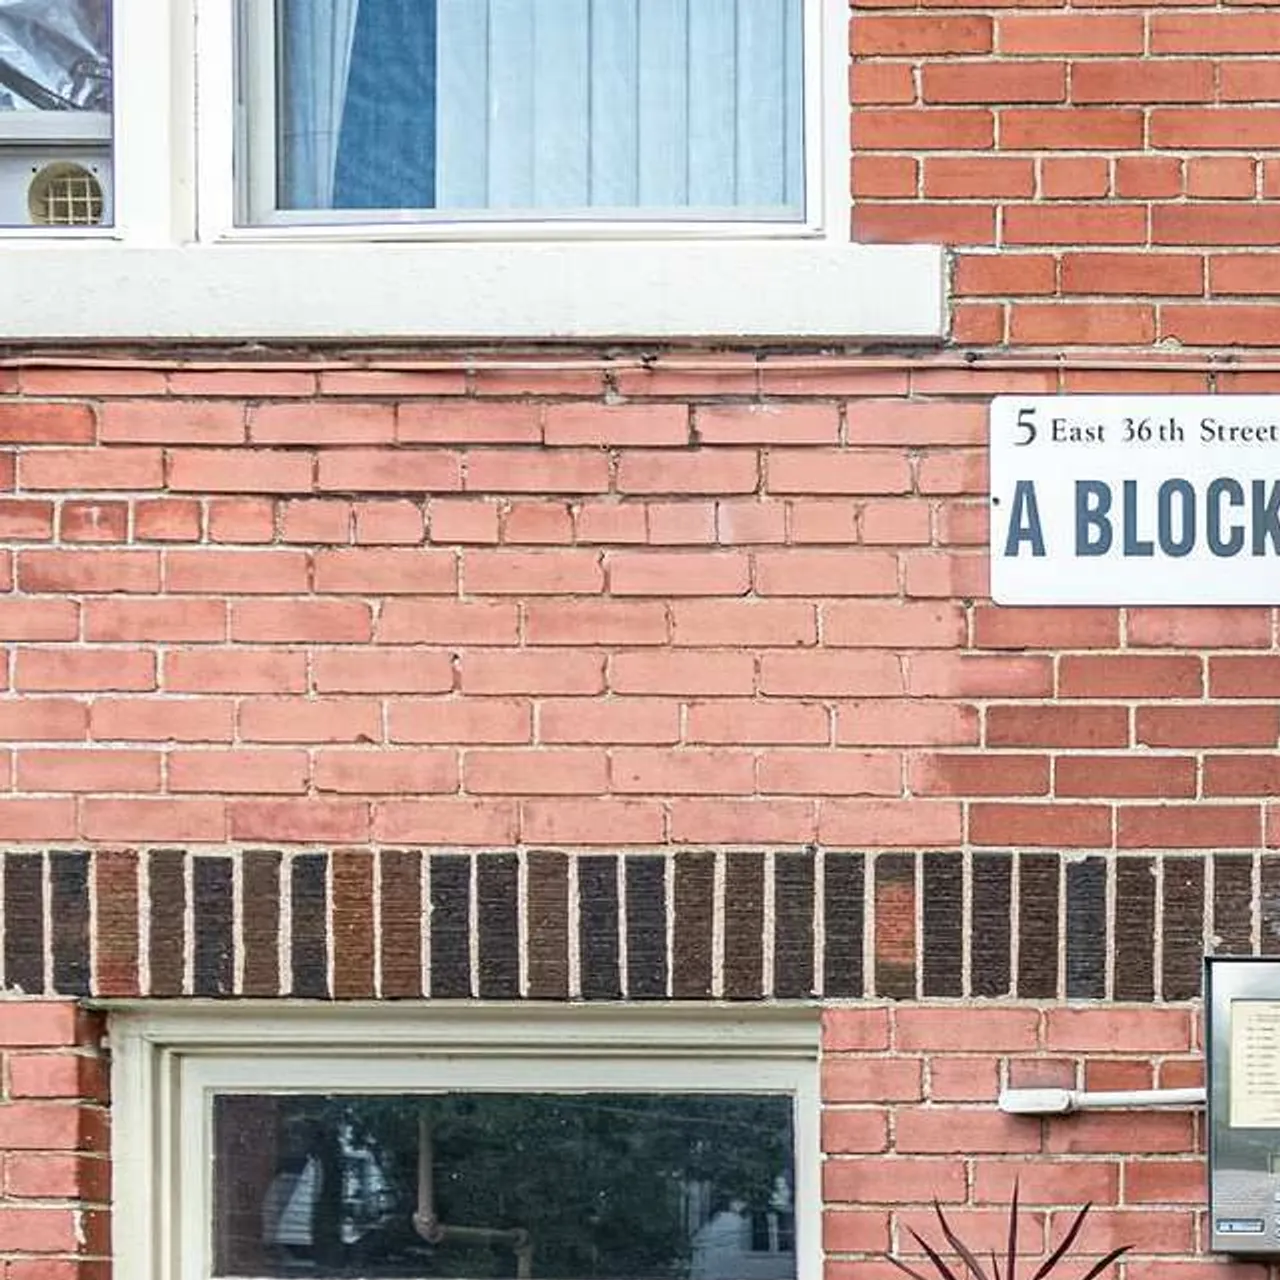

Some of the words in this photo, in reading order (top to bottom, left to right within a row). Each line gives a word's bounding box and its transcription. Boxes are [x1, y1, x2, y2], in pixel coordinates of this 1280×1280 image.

[1014, 407, 1037, 446] 5
[1051, 418, 1105, 443] East
[1121, 417, 1185, 443] 36th
[1199, 418, 1278, 443] Street
[1003, 479, 1047, 557] A
